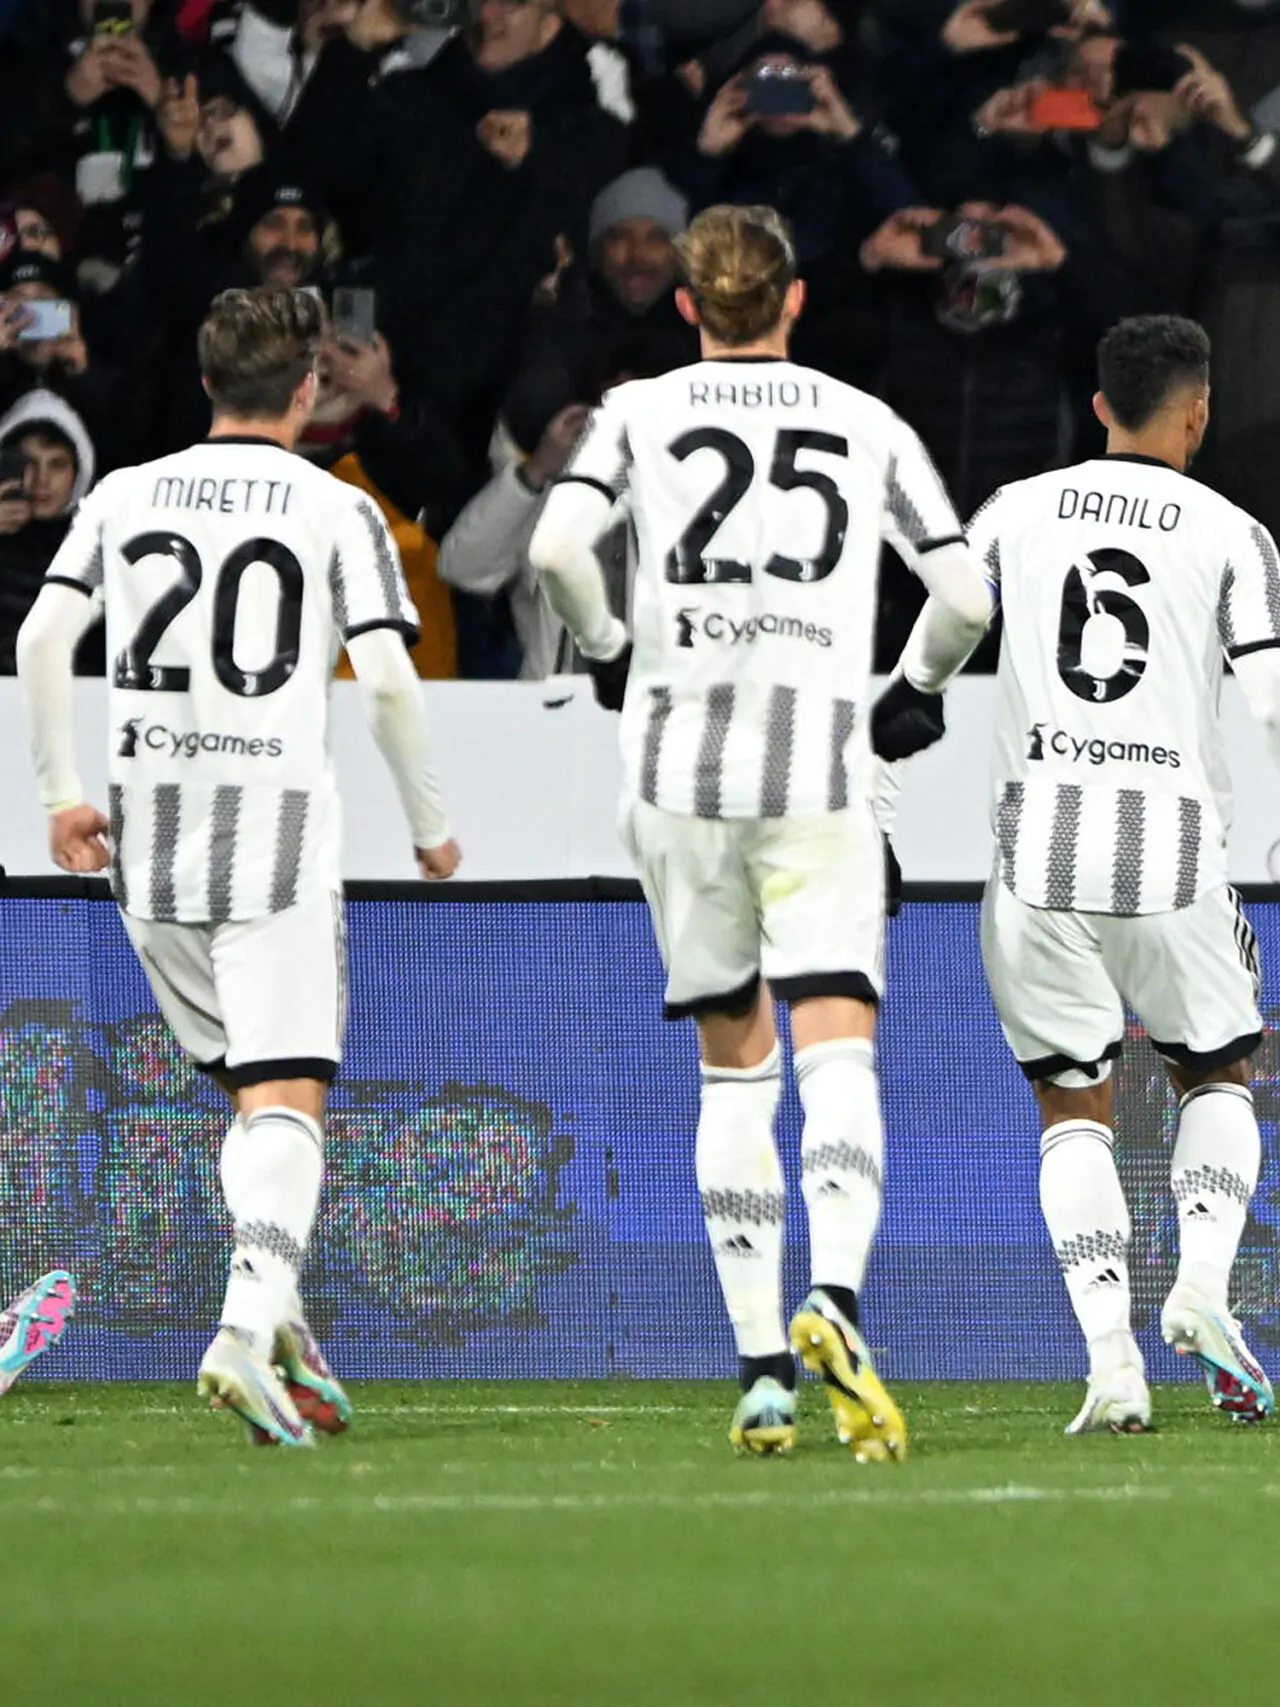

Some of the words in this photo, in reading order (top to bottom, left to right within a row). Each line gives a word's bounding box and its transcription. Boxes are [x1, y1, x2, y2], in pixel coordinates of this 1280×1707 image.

[689, 381, 820, 408] RABIOT
[152, 476, 292, 514] MIRETTI
[666, 426, 849, 583] 25
[1058, 488, 1181, 531] DANILO
[113, 530, 304, 698] 20
[703, 613, 833, 648] Cygames
[1056, 547, 1151, 703] 6
[144, 725, 283, 758] Cygames
[1051, 730, 1181, 769] Cygames
